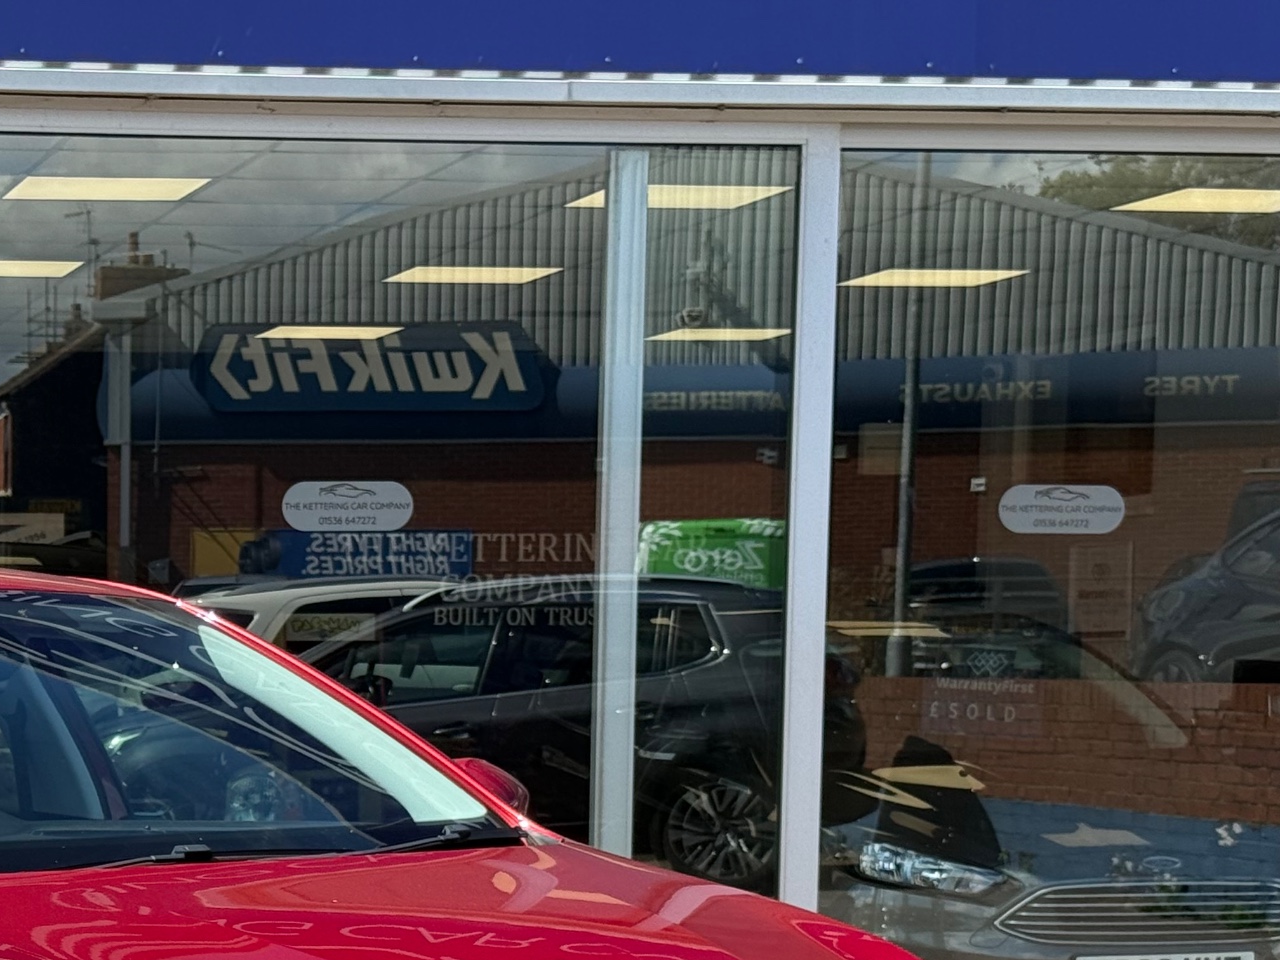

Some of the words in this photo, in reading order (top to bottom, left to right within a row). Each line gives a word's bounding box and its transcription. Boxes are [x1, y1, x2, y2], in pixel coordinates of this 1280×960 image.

[285, 502, 301, 511] THE
[303, 502, 349, 511] KETTERING
[350, 502, 368, 511] CAR
[370, 502, 410, 511] COMPANY
[1019, 504, 1064, 513] KETTERING
[1065, 504, 1081, 513] CAR
[318, 516, 343, 525] 01536
[345, 516, 377, 525] 647272
[1058, 519, 1089, 528] 647272
[433, 606, 499, 626] BUILT
[506, 606, 536, 627] ON
